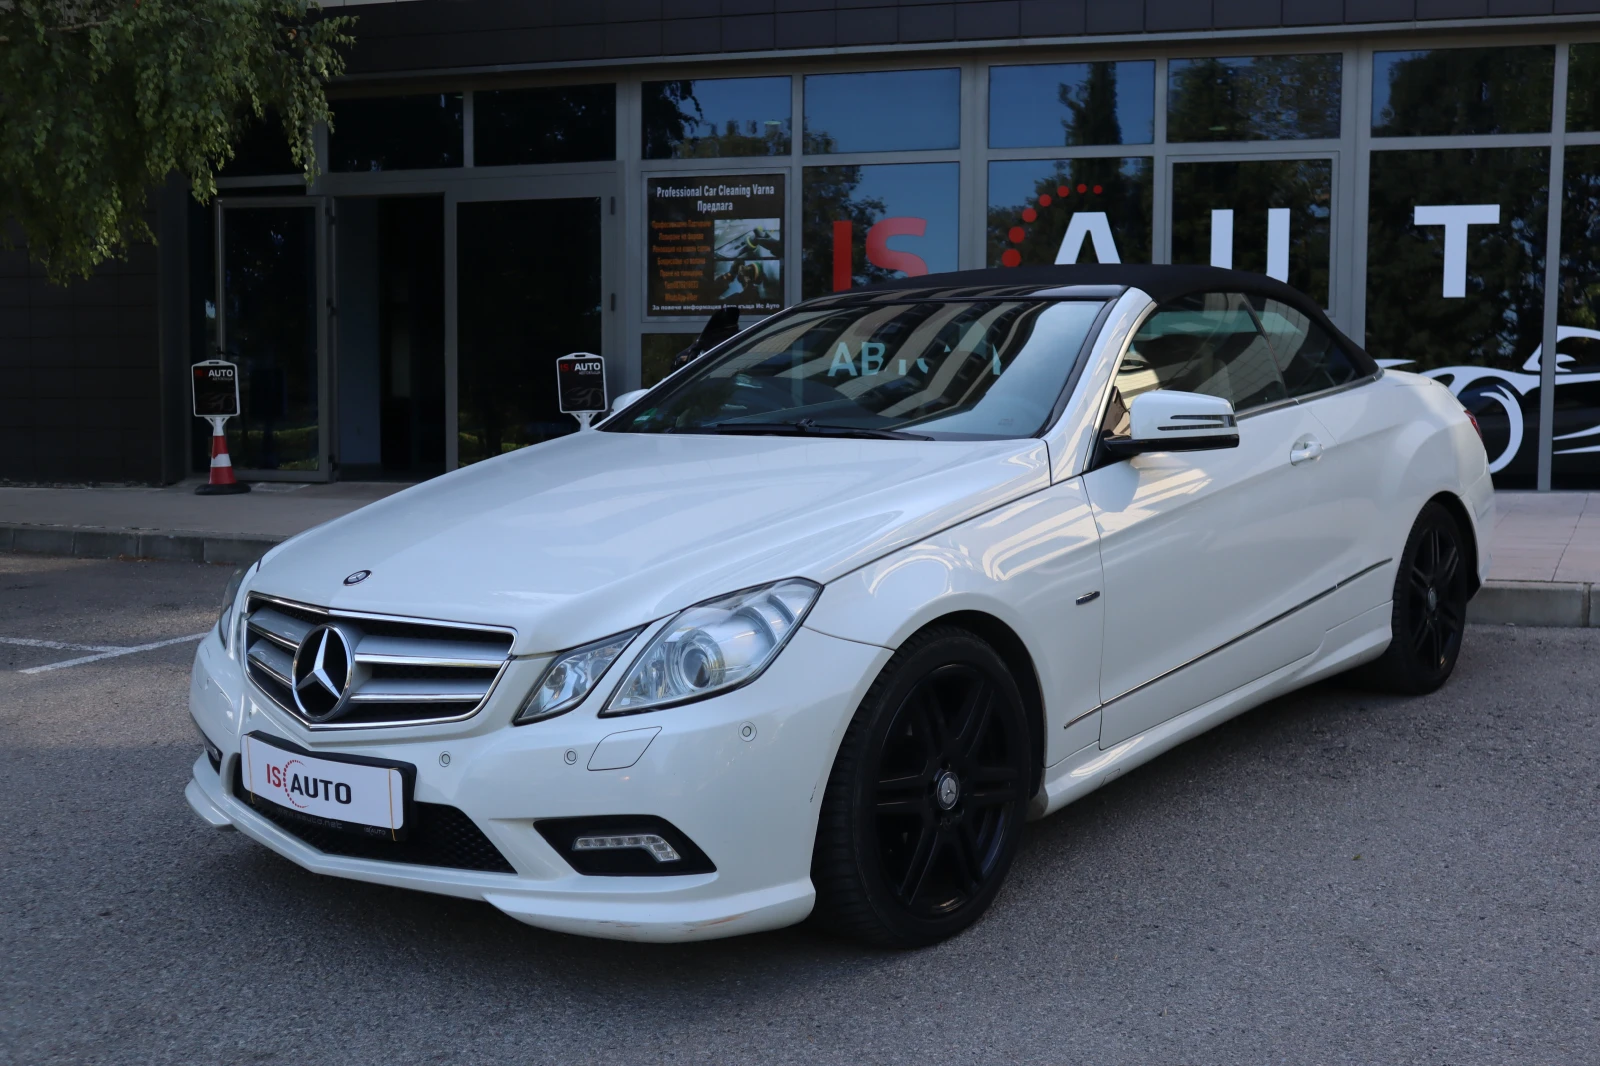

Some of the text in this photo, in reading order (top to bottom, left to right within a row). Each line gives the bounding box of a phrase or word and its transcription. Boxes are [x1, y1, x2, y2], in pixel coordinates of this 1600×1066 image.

[657, 184, 775, 198] Professional Car Cleaning Varna
[697, 201, 733, 213] Предлага
[683, 304, 721, 312] информация
[574, 362, 601, 371] AUTO
[209, 369, 233, 377] AUTO
[266, 763, 352, 805] IS AUTO
